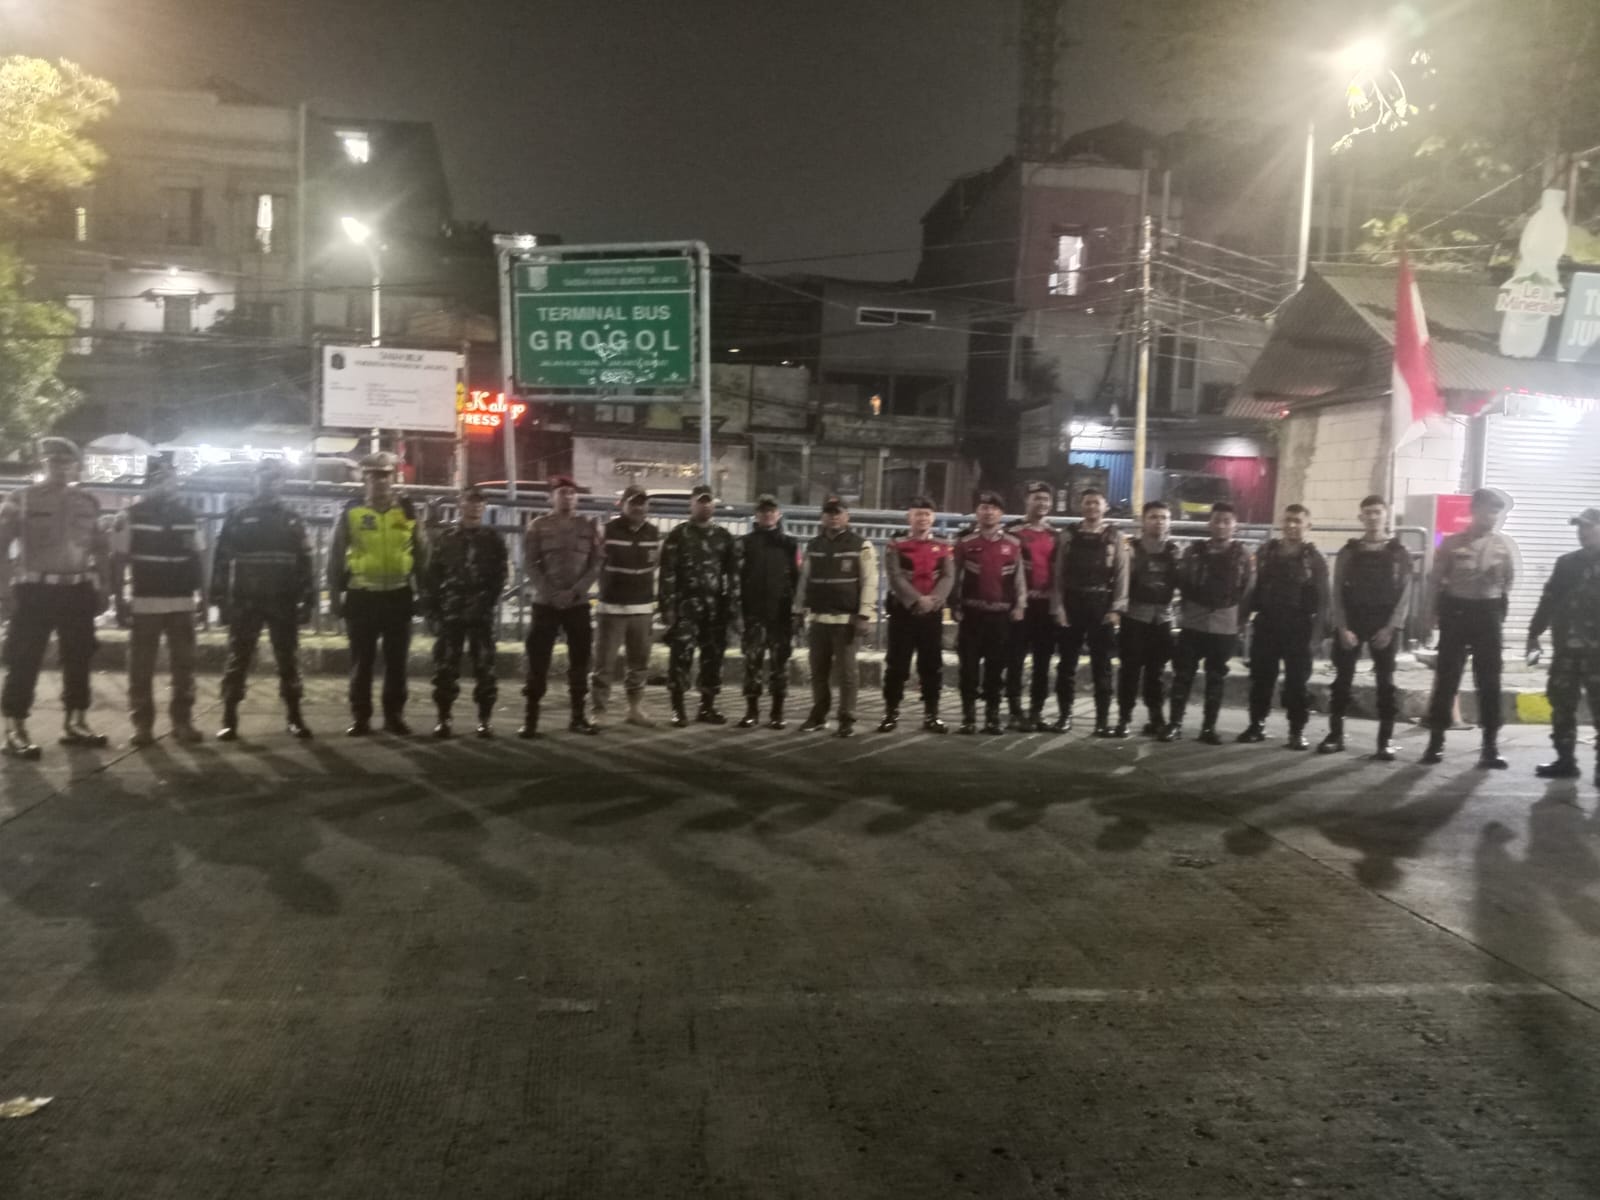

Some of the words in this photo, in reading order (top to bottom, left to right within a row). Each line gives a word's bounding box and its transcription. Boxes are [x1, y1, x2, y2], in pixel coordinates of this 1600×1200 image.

[1523, 282, 1541, 298] Le
[536, 306, 628, 321] TERMINAL
[632, 305, 671, 320] BUS
[528, 330, 680, 351] GROGOL
